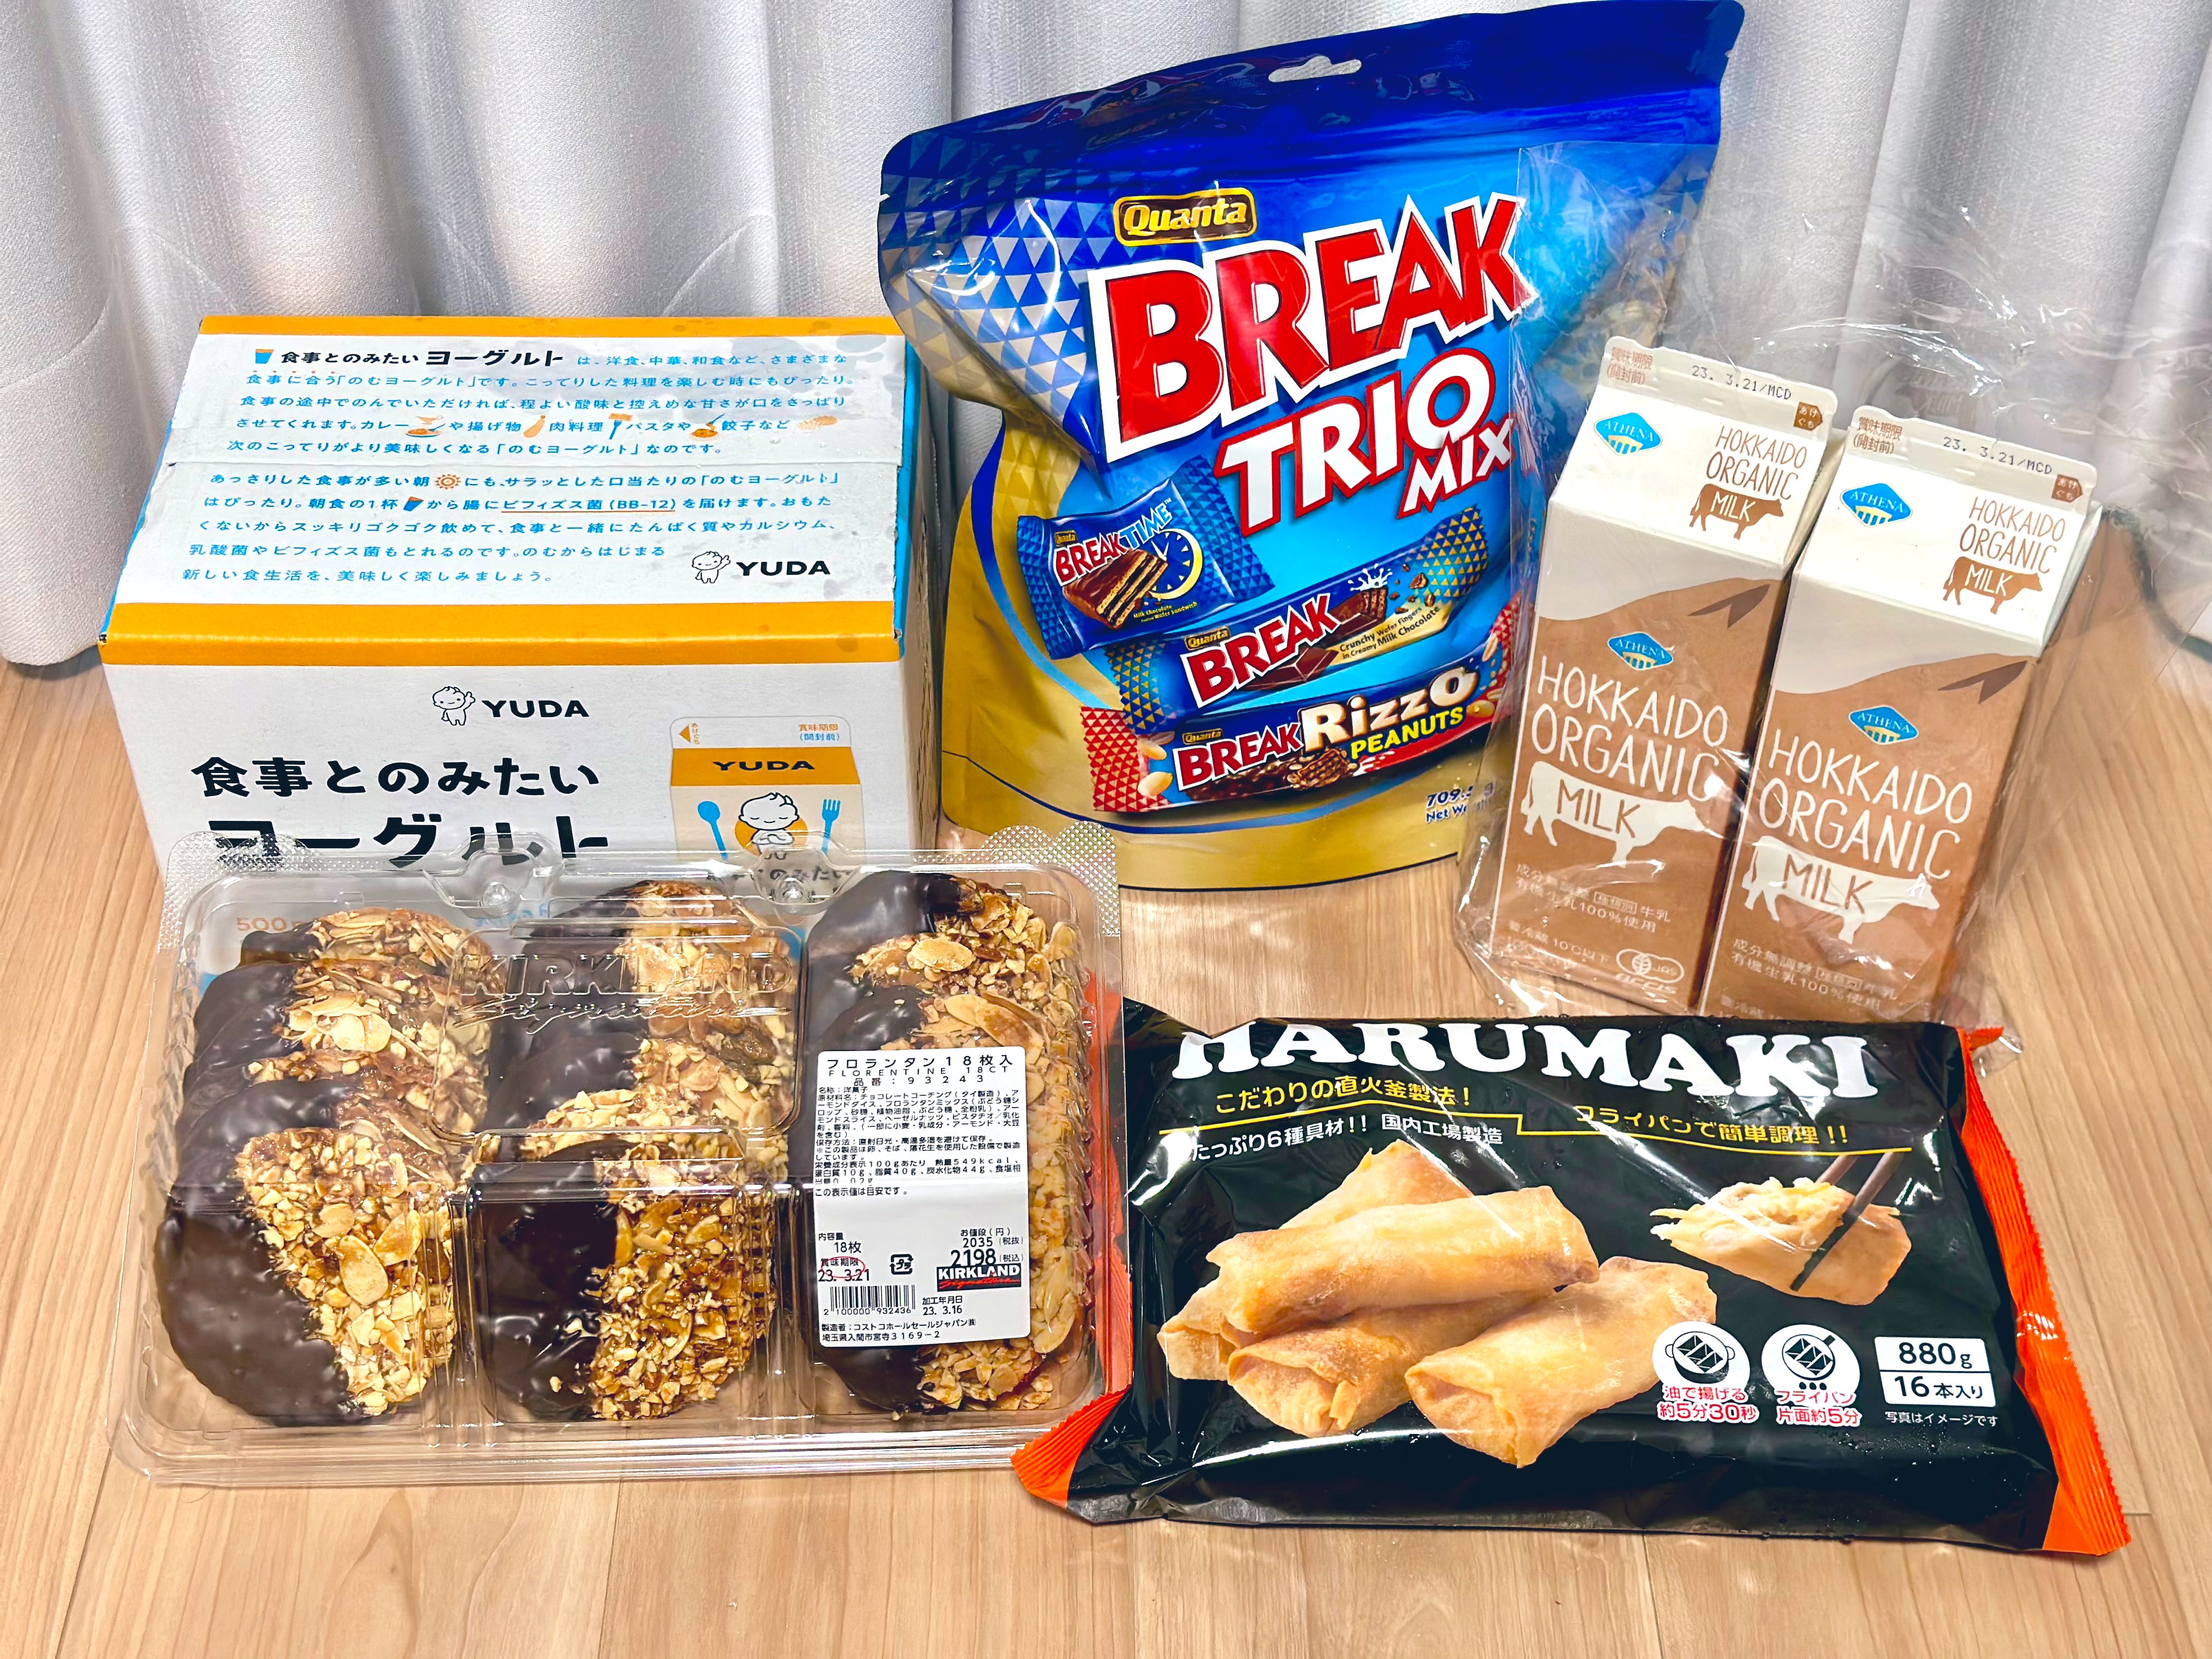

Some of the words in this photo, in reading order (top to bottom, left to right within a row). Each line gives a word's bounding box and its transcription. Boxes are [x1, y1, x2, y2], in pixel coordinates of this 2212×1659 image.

[1124, 201, 1246, 235] Quanta
[1088, 192, 1538, 462] BREAK
[281, 351, 419, 365] 食事とのみたい
[425, 349, 563, 367] ヨーグルト
[549, 421, 603, 433] 肉料理
[1603, 420, 1654, 443] ATHENA
[1215, 348, 1495, 537] TRIO
[1716, 425, 1808, 469] HOKKAIDO
[1397, 414, 1517, 519] MIX
[1706, 451, 1798, 500] ORGANIC
[1710, 491, 1757, 522] MILK
[1850, 492, 1904, 514] ATHENA
[1968, 496, 2066, 541] HOKKAIDO
[1960, 523, 2057, 574] ORGANIC
[736, 561, 831, 576] YUDA
[1965, 564, 2013, 596] MILK
[1187, 629, 1229, 647] Quanta
[1340, 633, 1375, 652] Crunchy
[1376, 623, 1398, 636] Wafer
[1398, 607, 1423, 625] Fingers
[1351, 642, 1377, 657] Creamy
[1378, 633, 1398, 646] Milk
[1398, 606, 1440, 636] Chocolate
[1181, 593, 1342, 708] BREAK
[1615, 638, 1666, 660] ATHENA
[482, 699, 589, 718] YUDA
[1537, 654, 1728, 747] HOKKAIDO
[1351, 706, 1464, 760] PEANUTS
[1857, 712, 1911, 733] ATHENA
[1183, 729, 1223, 744] Quanta
[1174, 722, 1304, 791] BREAK
[1531, 703, 1720, 802] ORGANIC
[191, 756, 600, 797] 食事とのみたい
[713, 760, 815, 771] YUDA
[1768, 729, 1973, 824] HOKKAIDO
[1426, 808, 1449, 823] Net
[1557, 778, 1641, 839] MILK
[1759, 777, 1961, 879] ORGANIC
[1783, 854, 1873, 915] MILK
[828, 1067, 947, 1077] FLORENTINE
[966, 1065, 1009, 1074] 18CT
[1172, 1021, 1878, 1098] HARUMAKI
[1381, 1113, 1503, 1146] 国内工場製造
[818, 1232, 844, 1241] 内容量
[834, 1240, 862, 1254] 18枚
[962, 1236, 994, 1248] 2035
[950, 1248, 996, 1267] 2198
[938, 1265, 1020, 1280] KIRKLAND
[922, 1295, 963, 1305] 加工年月日
[1663, 1385, 1747, 1402] 油で揚げる
[1776, 1389, 1857, 1406] フライパン
[1893, 1375, 1984, 1400] 16本入り
[1657, 1402, 1759, 1421] 約5分30秒
[1777, 1406, 1862, 1426] 片面約5分
[1884, 1411, 1998, 1427] 写真はイメージです
